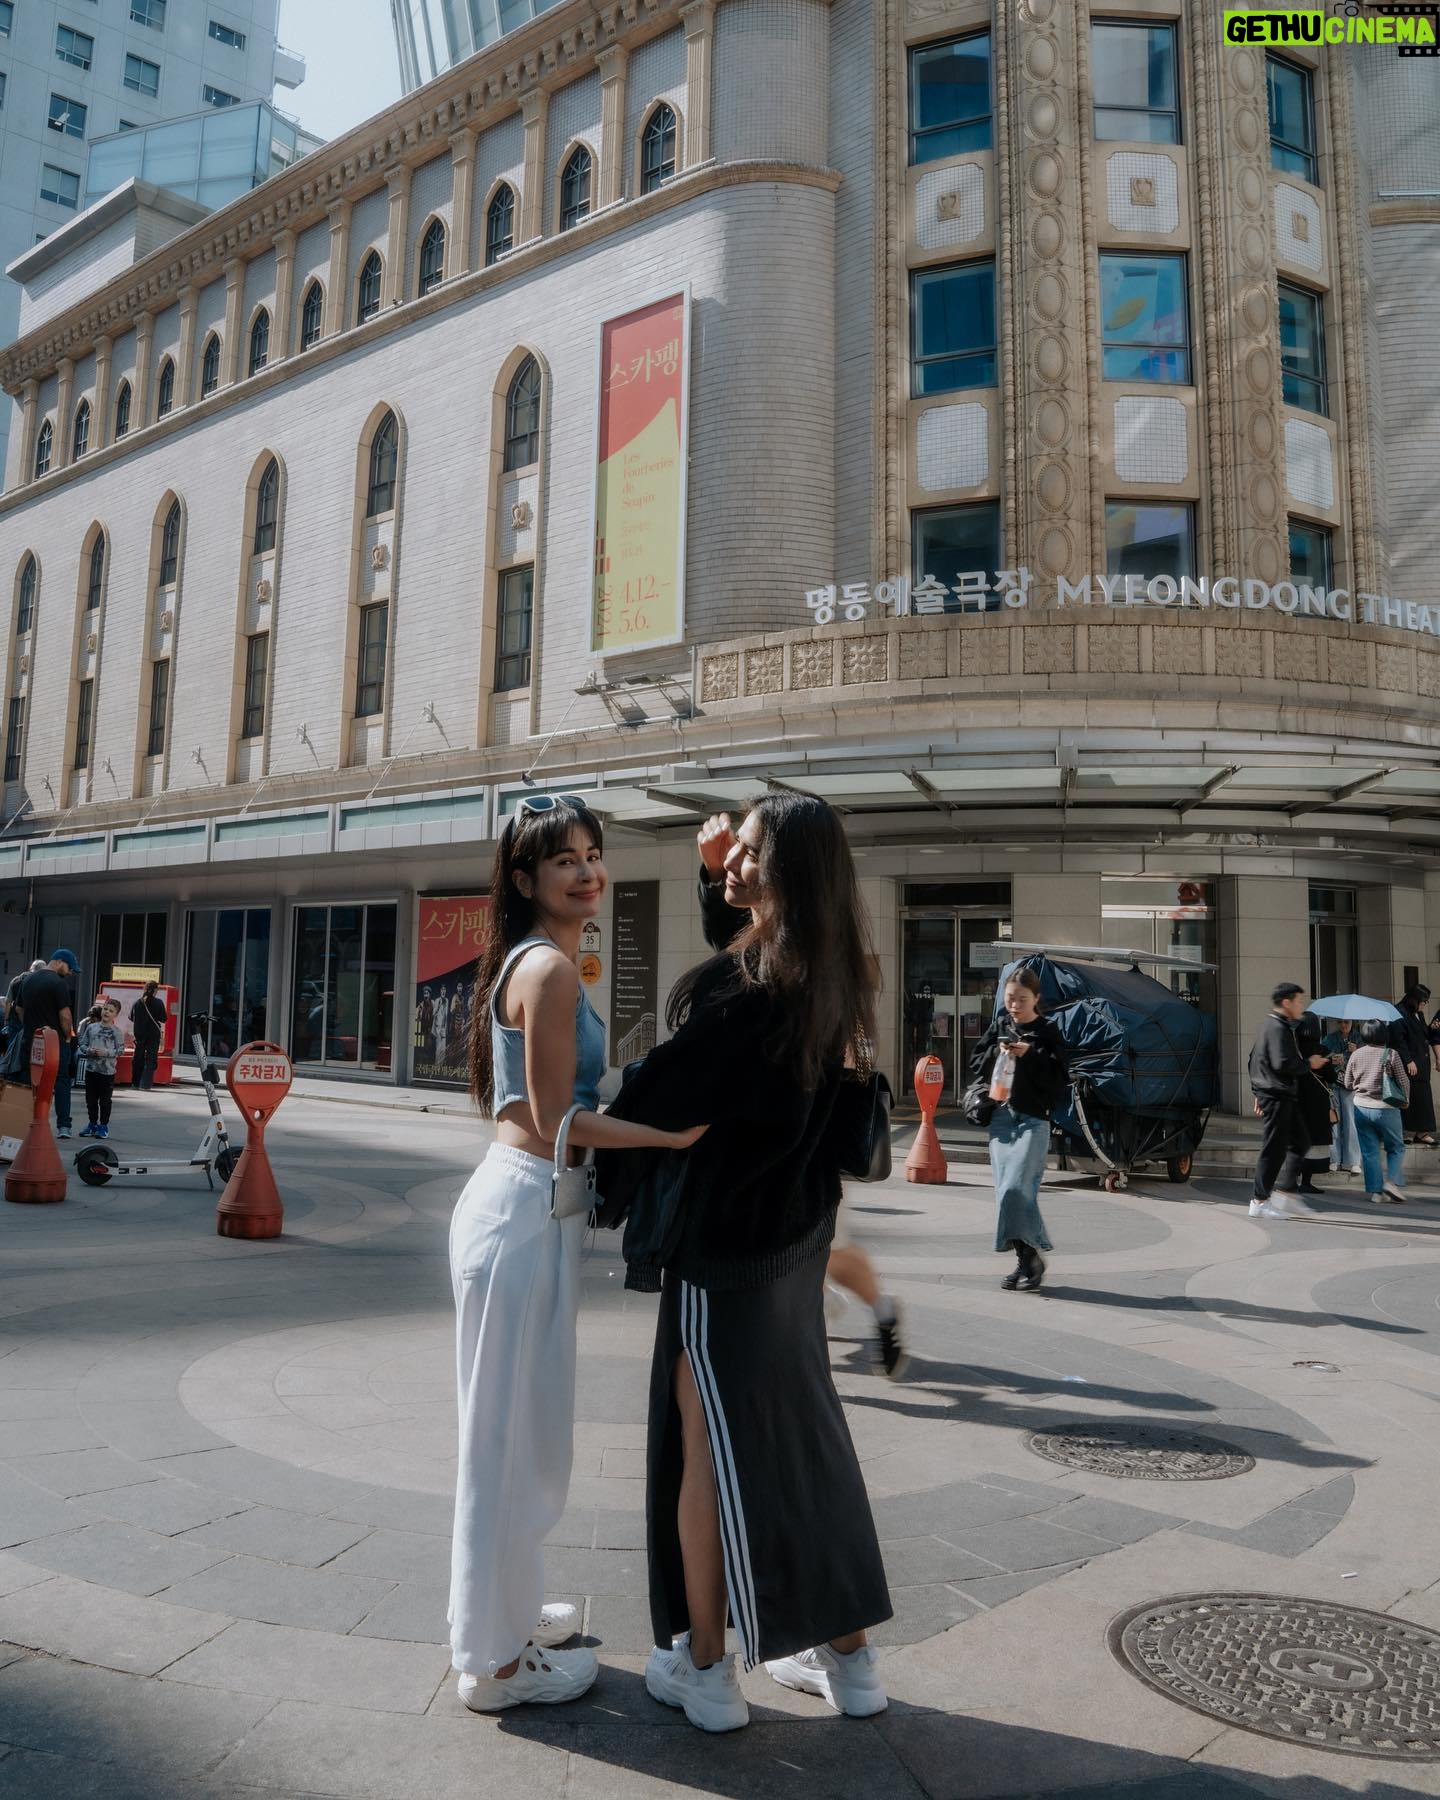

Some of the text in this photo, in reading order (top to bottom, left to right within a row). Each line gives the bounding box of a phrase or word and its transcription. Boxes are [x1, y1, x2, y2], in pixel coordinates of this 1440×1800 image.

[604, 337, 680, 393] 스카팽
[804, 566, 1034, 626] 명동예술극장
[1055, 573, 1351, 620] MYEONGDONG
[421, 906, 491, 946] 스카팽
[585, 935, 595, 945] 35
[239, 1064, 286, 1080] 주차금지
[1276, 1651, 1368, 1681] KT
